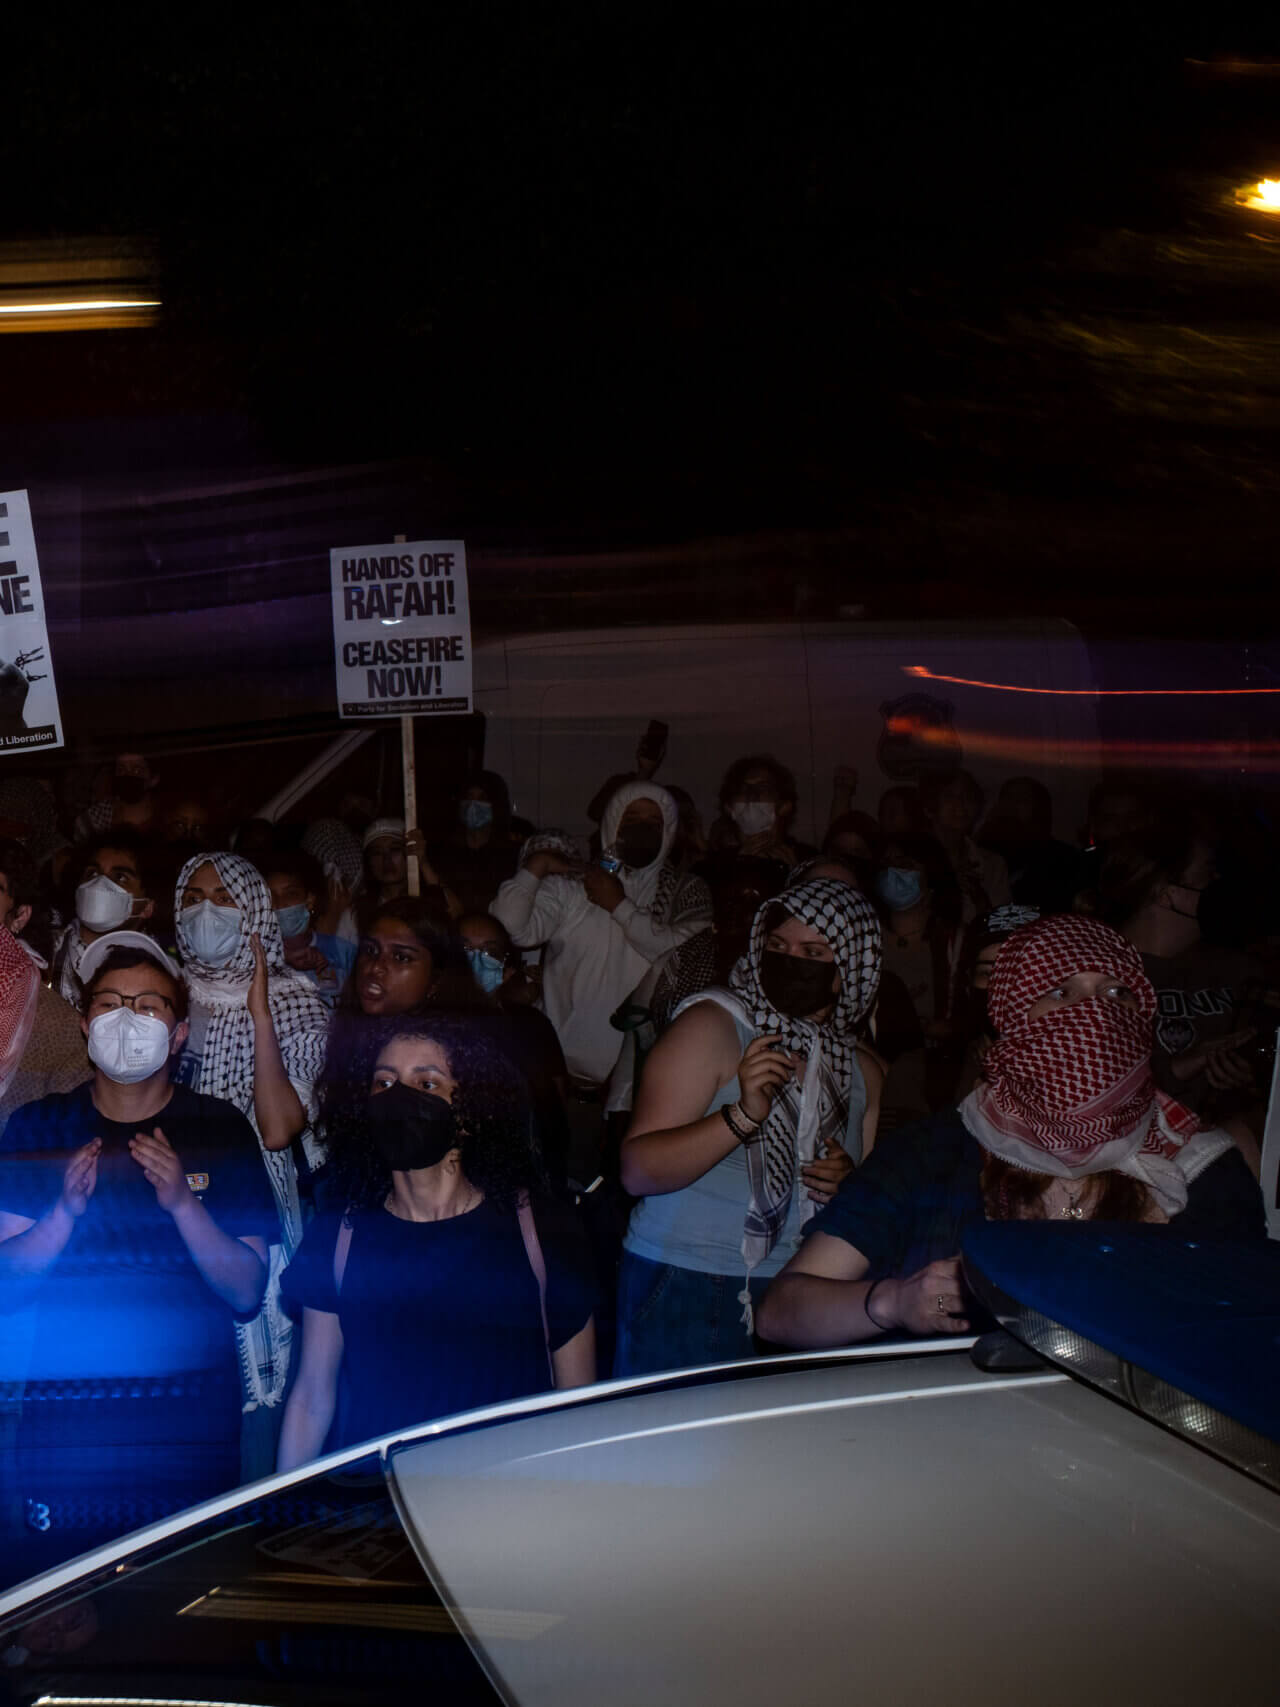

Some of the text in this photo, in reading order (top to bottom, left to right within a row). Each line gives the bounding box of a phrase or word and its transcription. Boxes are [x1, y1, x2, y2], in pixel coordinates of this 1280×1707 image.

[342, 553, 455, 582] HANDS OFF
[343, 580, 456, 621] RAFAH!
[342, 636, 464, 667] CEASEFIRE
[366, 665, 442, 698] NOW!
[5, 731, 53, 746] Liberation
